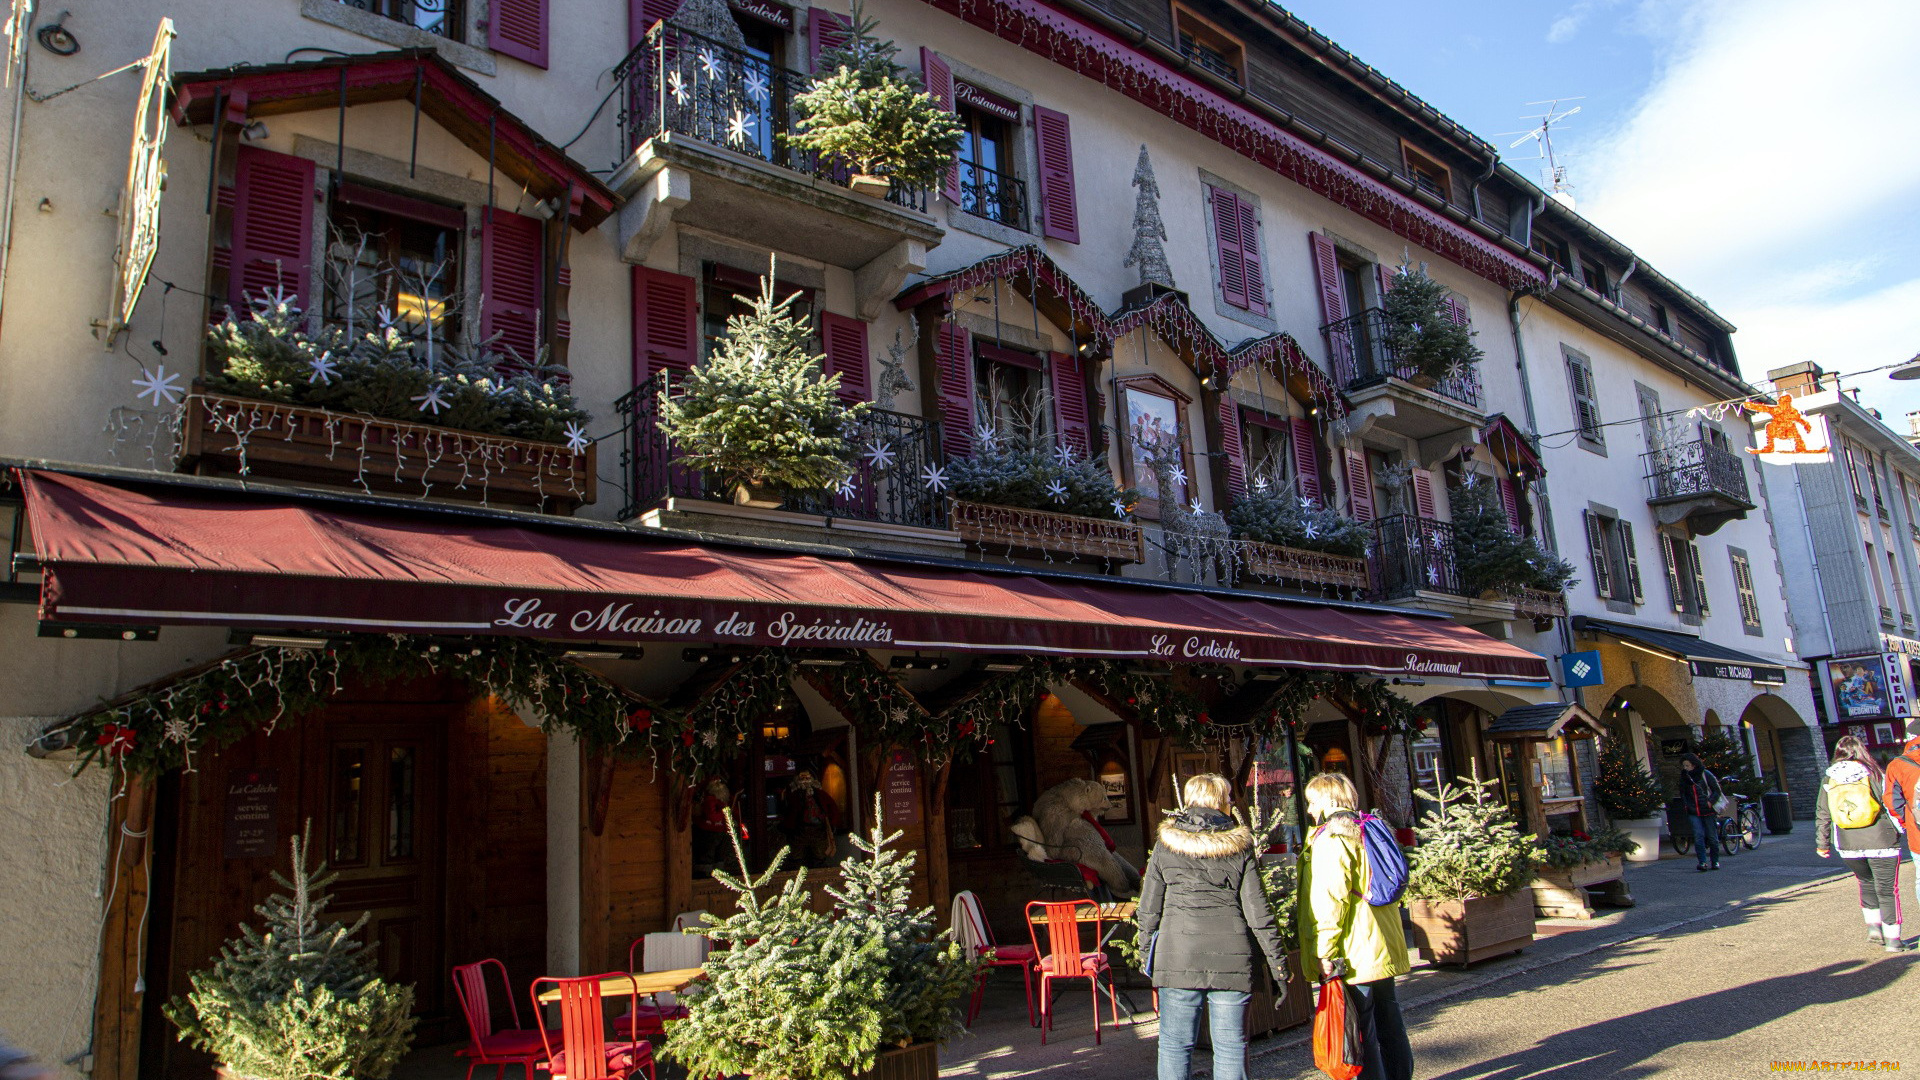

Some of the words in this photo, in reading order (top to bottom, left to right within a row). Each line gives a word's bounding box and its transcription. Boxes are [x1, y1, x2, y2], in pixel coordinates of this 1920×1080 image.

[955, 82, 1019, 120] Restaurant
[494, 598, 557, 629] La
[570, 602, 702, 635] Maison
[714, 612, 755, 638] des
[768, 611, 893, 646] Spécialités
[1150, 634, 1175, 656] La
[1183, 636, 1241, 661] Calèche
[1404, 653, 1462, 675] Restaurant
[1715, 666, 1728, 678] CHEZ
[1728, 665, 1753, 679] RICHARD
[1887, 655, 1908, 715] CINEMA
[229, 785, 242, 794] La
[244, 784, 278, 793] Calèche
[238, 804, 268, 812] service
